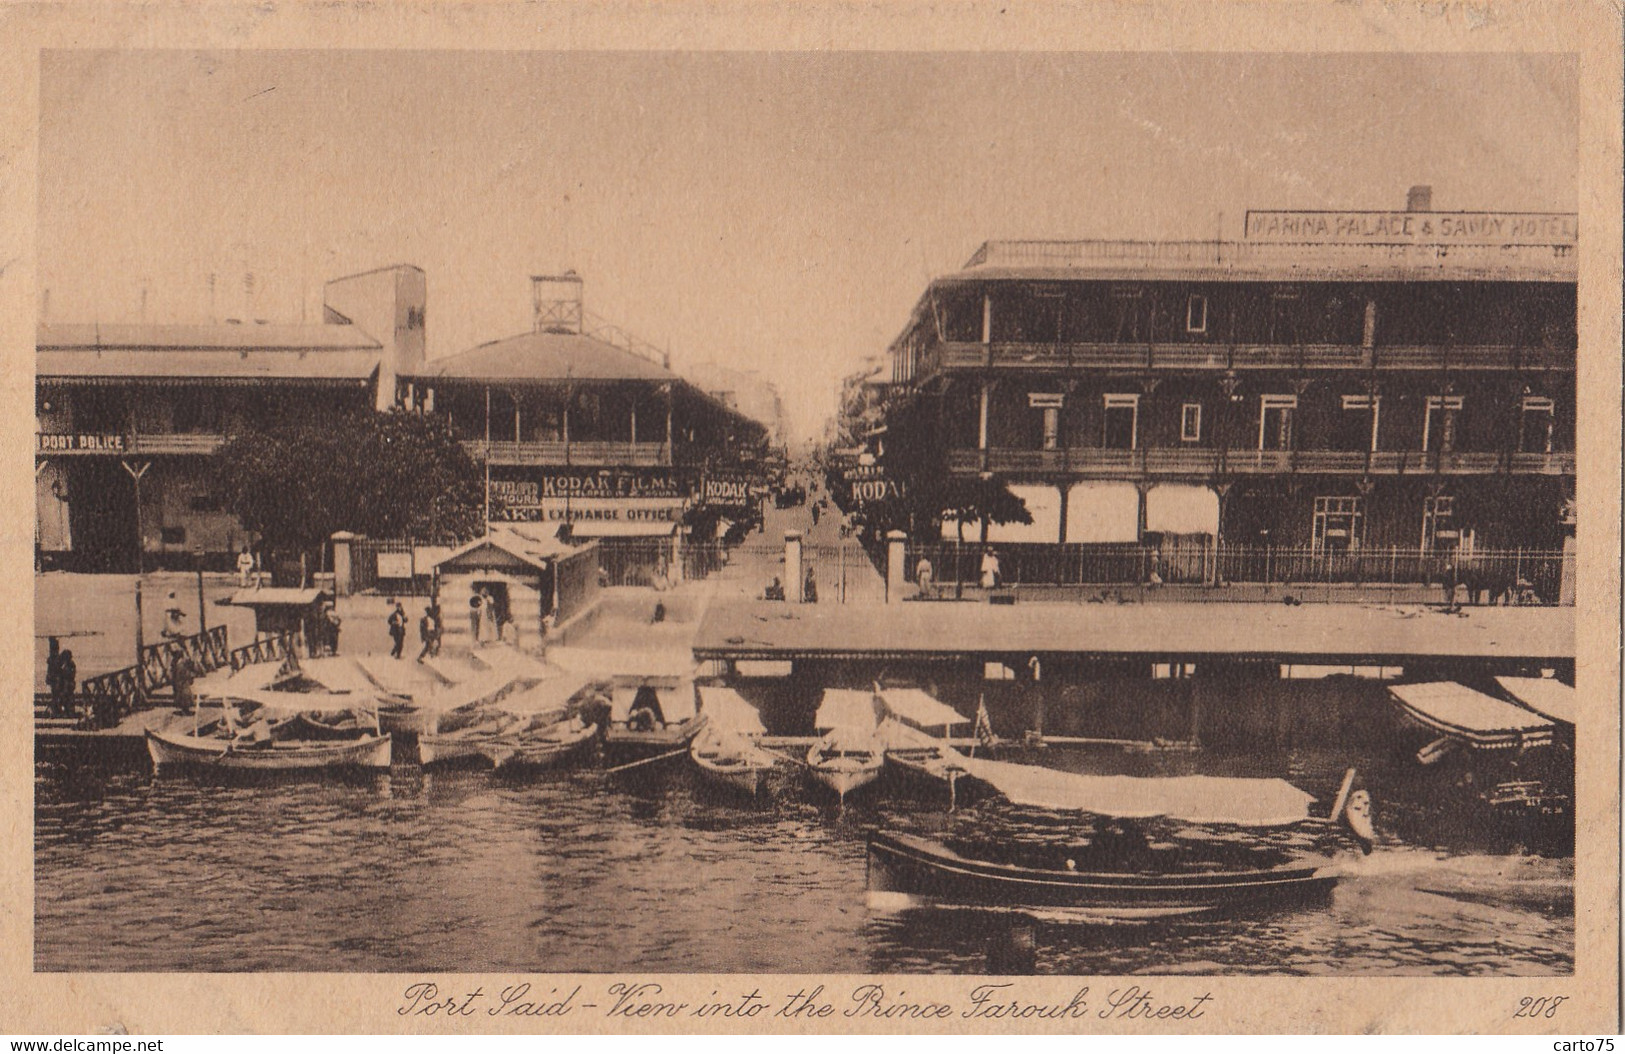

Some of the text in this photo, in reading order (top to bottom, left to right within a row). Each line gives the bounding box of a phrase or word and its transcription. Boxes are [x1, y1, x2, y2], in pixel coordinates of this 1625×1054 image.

[1252, 216, 1329, 236] MARINA
[1336, 216, 1413, 236] PALACE
[1422, 219, 1433, 235] &
[1511, 217, 1574, 237] HOTEL
[42, 435, 123, 450] PORT POLICE
[542, 476, 678, 497] KODAK FILMS
[556, 488, 612, 497] DEVELOPED
[705, 480, 748, 498] KODAK
[548, 508, 673, 520] EXCHANGE OFFICE
